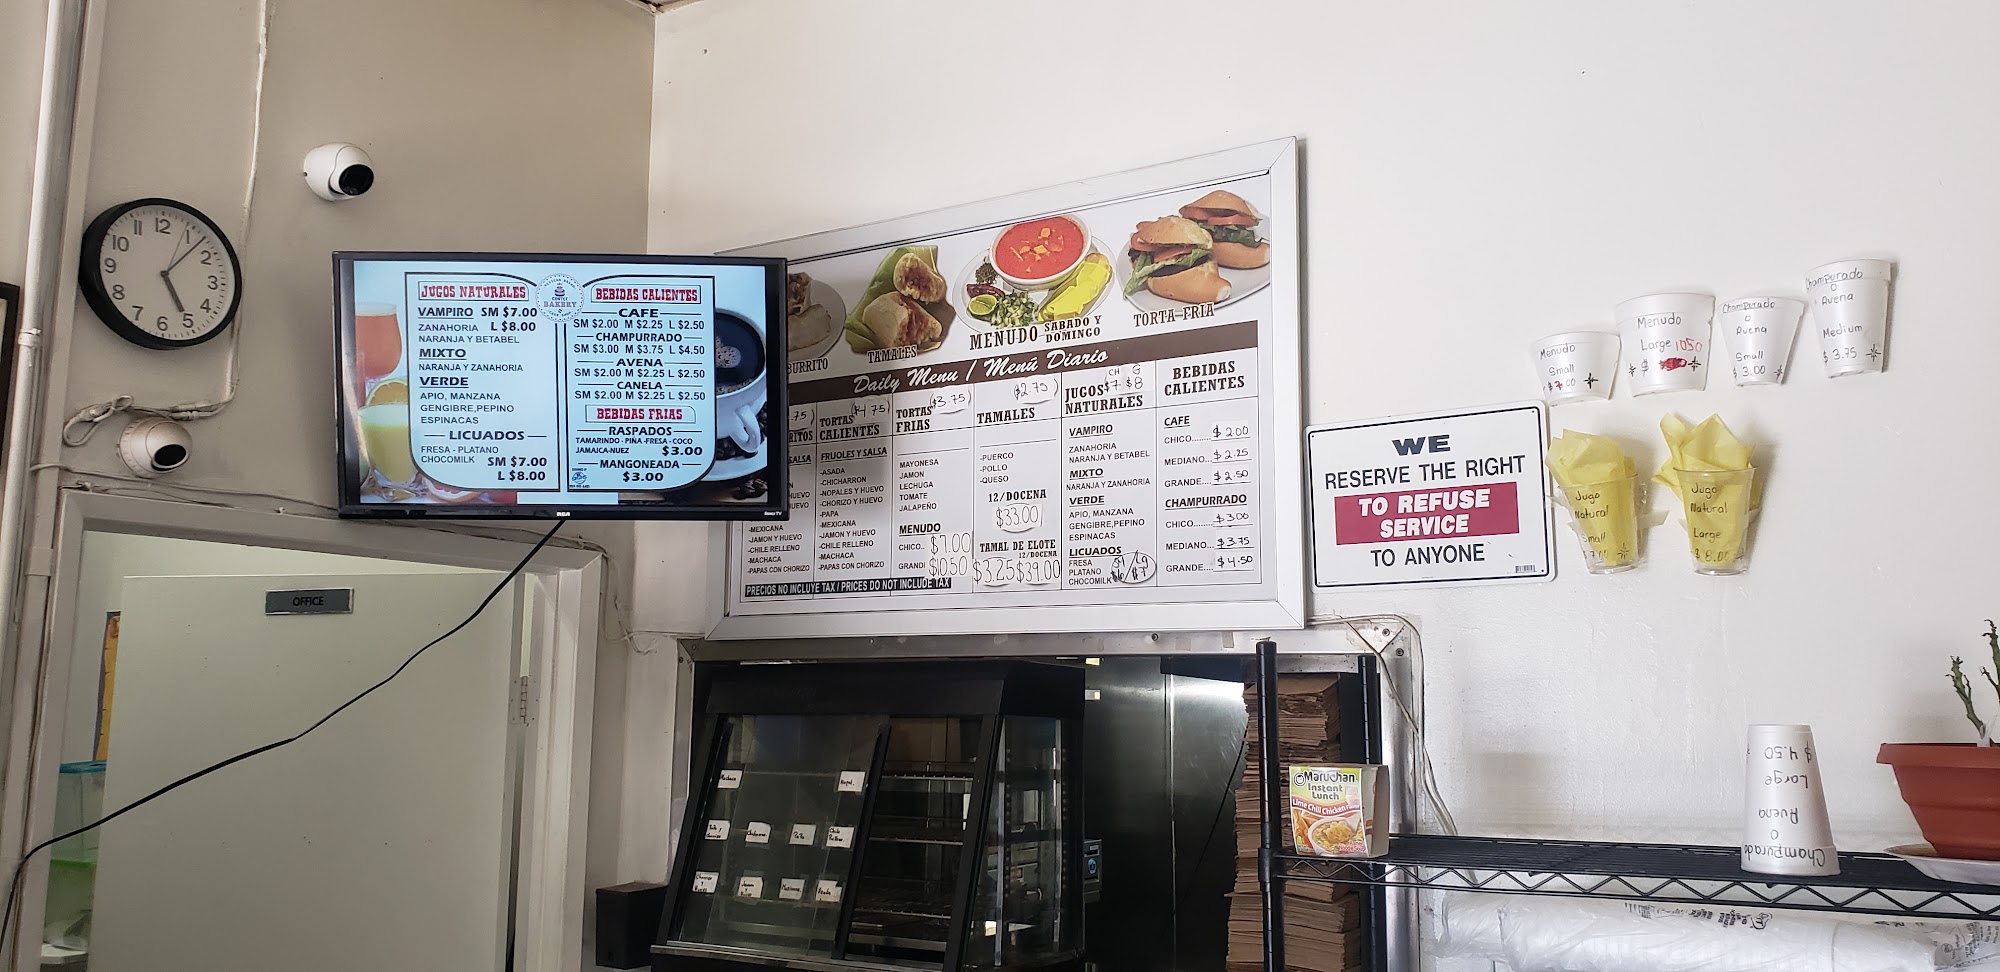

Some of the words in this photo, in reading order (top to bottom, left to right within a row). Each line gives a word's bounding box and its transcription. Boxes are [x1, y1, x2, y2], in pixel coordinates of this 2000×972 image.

[134, 219, 143, 236] 11
[155, 217, 171, 235] 12
[112, 234, 130, 252] 10
[421, 286, 455, 298] JUGOS
[460, 286, 526, 299] NATURALES
[596, 288, 639, 300] BEBIDAS
[642, 289, 698, 301] CALIENTES
[418, 307, 474, 317] VAMPIRO
[481, 307, 499, 317] SM
[503, 306, 538, 318] $7.00
[618, 308, 659, 318] CAFE
[1133, 310, 1176, 327] TORTA
[1182, 303, 1215, 321] FRIA
[418, 324, 479, 332] ZANAHORIA
[490, 322, 498, 331] L
[502, 322, 536, 332] $8.00
[573, 319, 589, 328] SM
[592, 319, 619, 329] $2.00
[625, 320, 633, 329] M
[636, 320, 663, 329] $2.25
[669, 321, 675, 329] L
[678, 320, 705, 330] $2.50
[1044, 317, 1090, 332] SABADO
[1094, 315, 1103, 325] Y
[1637, 314, 1682, 330] Menudo
[595, 332, 682, 342] CHAMPURRADO
[970, 326, 1038, 350] MENUDO
[1046, 327, 1101, 343] DOMINGO
[1823, 324, 1863, 339] Medium
[476, 336, 520, 344] BETABEL
[1640, 339, 1672, 353] Large
[419, 349, 467, 358] MIXTO
[868, 346, 918, 364] TAMALES
[1540, 344, 1576, 360] Menudo
[1736, 350, 1764, 362] Small
[616, 358, 663, 367] AVENA
[853, 374, 901, 394] Daily
[907, 367, 959, 387] Menu
[983, 357, 1039, 377] Menú
[1047, 349, 1109, 369] Diario
[1173, 360, 1235, 380] BEBIDAS
[1549, 364, 1575, 377] Small
[420, 376, 469, 386] VERDE
[617, 381, 663, 390] CANELA
[1164, 375, 1245, 396] CALIENTES
[420, 392, 447, 401] APIO,
[450, 392, 501, 400] MANZANA
[1065, 384, 1104, 403] JUGOS
[420, 405, 514, 413] GENGIBRE,PEPINO
[1065, 395, 1143, 415] NATURALES
[597, 408, 645, 420] BEBIDAS
[648, 408, 683, 420] FRIAS
[896, 406, 932, 419] TORTAS
[976, 408, 1035, 424] TAMALES
[421, 416, 479, 424] ESPINACAS
[819, 415, 854, 427] TORTAS
[896, 419, 930, 433] FRIAS
[450, 431, 525, 440] LICUADOS
[608, 426, 672, 436] RASPADOS
[819, 425, 880, 441] CALIENTES
[1069, 424, 1113, 437] VAMPIRO
[625, 436, 643, 444] PIÑA
[1392, 434, 1451, 456] WE
[662, 445, 703, 456] $3.00
[856, 449, 862, 457] Y
[863, 447, 888, 457] SALSA
[1069, 442, 1117, 454] ZANAHORIA
[421, 456, 475, 464] CHOCOMILK
[980, 452, 1014, 461] -PUERCO
[600, 460, 680, 469] MANGONEADA
[899, 459, 939, 469] MAYONESA
[980, 464, 1008, 473] -POLLO
[622, 471, 664, 483] $3.00
[899, 471, 925, 480] JAMON
[1325, 465, 1410, 490] RESERVE
[1418, 462, 1456, 482] THE
[1466, 455, 1526, 478] RIGHT
[980, 475, 1009, 484] -QUESO
[860, 485, 884, 494] HUEVO
[899, 482, 934, 491] LECHUGA
[1691, 484, 1718, 500] Jugo
[899, 493, 928, 501] TOMATE
[988, 489, 1047, 503] 12/DOCENA
[1165, 494, 1247, 508] CHAMPURRADO
[1358, 496, 1389, 517] TO
[1397, 488, 1491, 514] REFUSE
[1575, 491, 1601, 507] Jugo
[899, 502, 937, 512] JALAPEÑO
[1574, 505, 1609, 519] Natural
[1690, 503, 1728, 514] Natural
[995, 505, 1039, 528] $33.00
[899, 523, 941, 534] MENUDO
[1380, 513, 1470, 539] SERVICE
[1582, 531, 1606, 543] Small
[1693, 527, 1722, 542] Large
[842, 540, 874, 548] RELLENO
[930, 532, 971, 556] $7.00
[980, 541, 1009, 553] TAMAL
[1013, 540, 1024, 551] DE
[1027, 539, 1056, 550] ELOTE
[1018, 550, 1057, 559] 12/DOCENA
[1370, 549, 1395, 567] TO
[1404, 543, 1485, 566] ANYONE
[928, 555, 968, 577] $10.50
[973, 559, 1015, 585] $3.25
[1016, 559, 1060, 583] $39.00
[746, 585, 777, 596] PRECIOS
[777, 584, 789, 595] NO
[790, 582, 820, 594] INCLUYE
[821, 582, 836, 593] TAX
[841, 581, 868, 592] PRICES
[869, 580, 880, 591] DO
[882, 579, 898, 590] NOT
[899, 577, 933, 589] INCLUDE
[935, 578, 950, 588] TAX
[292, 596, 324, 606] OFFICE
[1304, 771, 1355, 783] Maruchan
[1765, 769, 1808, 789] Large
[1308, 783, 1343, 792] Instant
[1312, 792, 1339, 800] Lunch
[1292, 798, 1308, 809] Lime
[1307, 803, 1322, 813] Chili
[1322, 805, 1346, 815] Chicken
[1758, 808, 1799, 825] Avena
